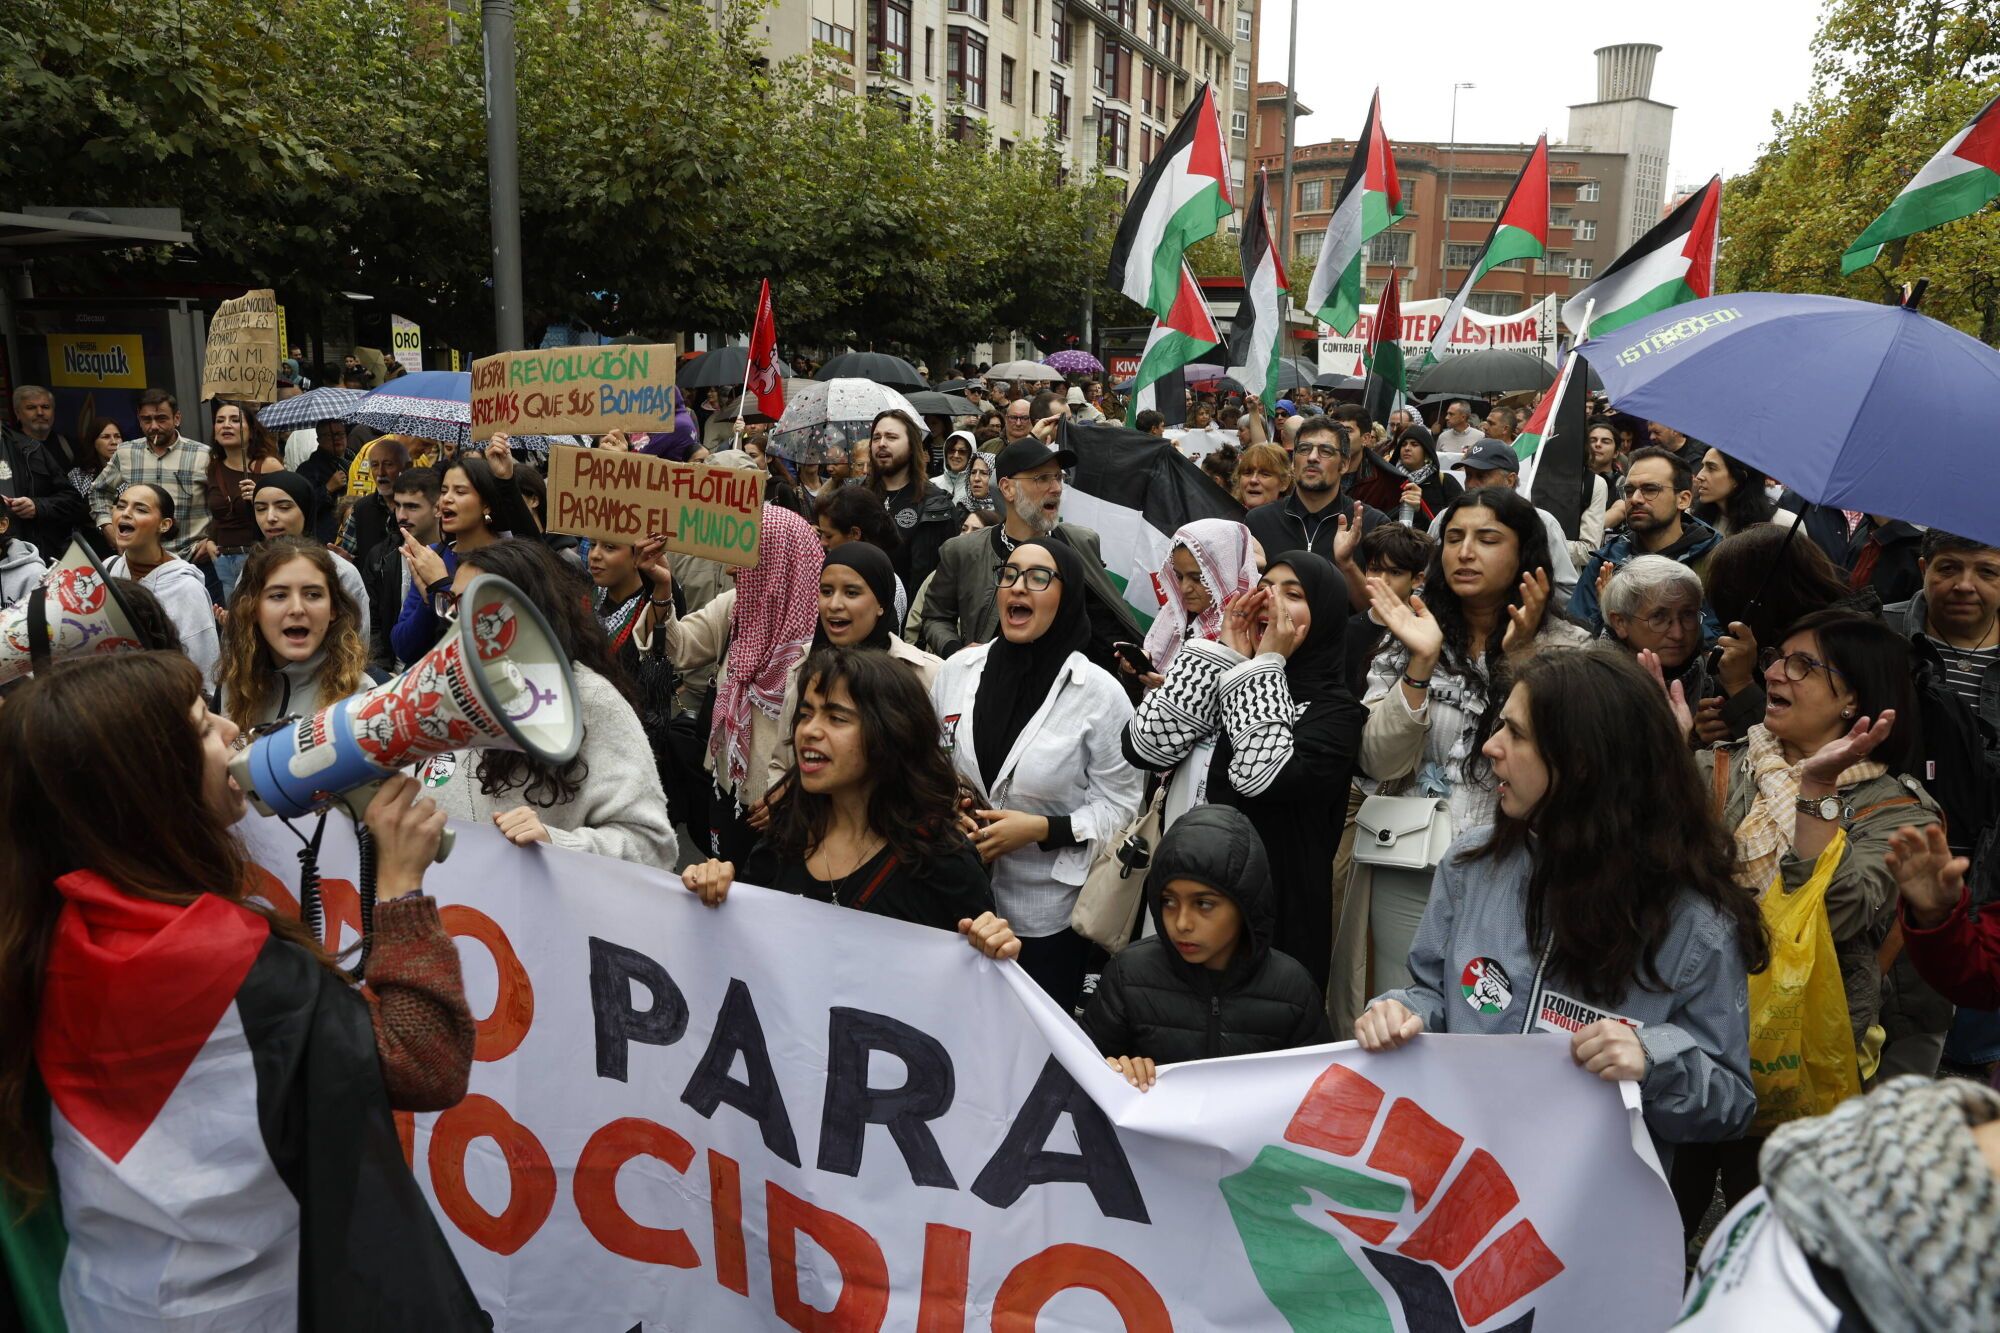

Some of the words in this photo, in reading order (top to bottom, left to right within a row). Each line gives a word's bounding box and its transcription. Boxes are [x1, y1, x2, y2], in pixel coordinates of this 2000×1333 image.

[394, 332, 419, 349] ORO
[1322, 341, 1352, 354] CONTRA
[1427, 313, 1538, 346] PLESTINA
[63, 343, 130, 382] Nesquik
[245, 347, 263, 364] MI
[471, 359, 505, 391] NUESTRA
[508, 346, 649, 388] REVOLUCIÓN
[1116, 360, 1140, 373] KIW
[204, 366, 256, 383] SILENCIO
[523, 392, 565, 419] QUE
[567, 388, 595, 417] SUS
[599, 383, 673, 422] BOMBAS
[574, 451, 642, 491] PARAN
[646, 463, 670, 492] LA
[671, 468, 759, 514] FLOTILLA
[559, 491, 642, 535] PARAMOS
[646, 508, 678, 539] EL
[678, 505, 756, 553] MUNDO
[445, 664, 499, 739] IZQUIERDA
[1541, 1008, 1588, 1033] REVOLUC
[1542, 994, 1618, 1025] IZQUIER
[588, 935, 1151, 1225] PARA
[393, 1092, 1174, 1333] OCIDIO
